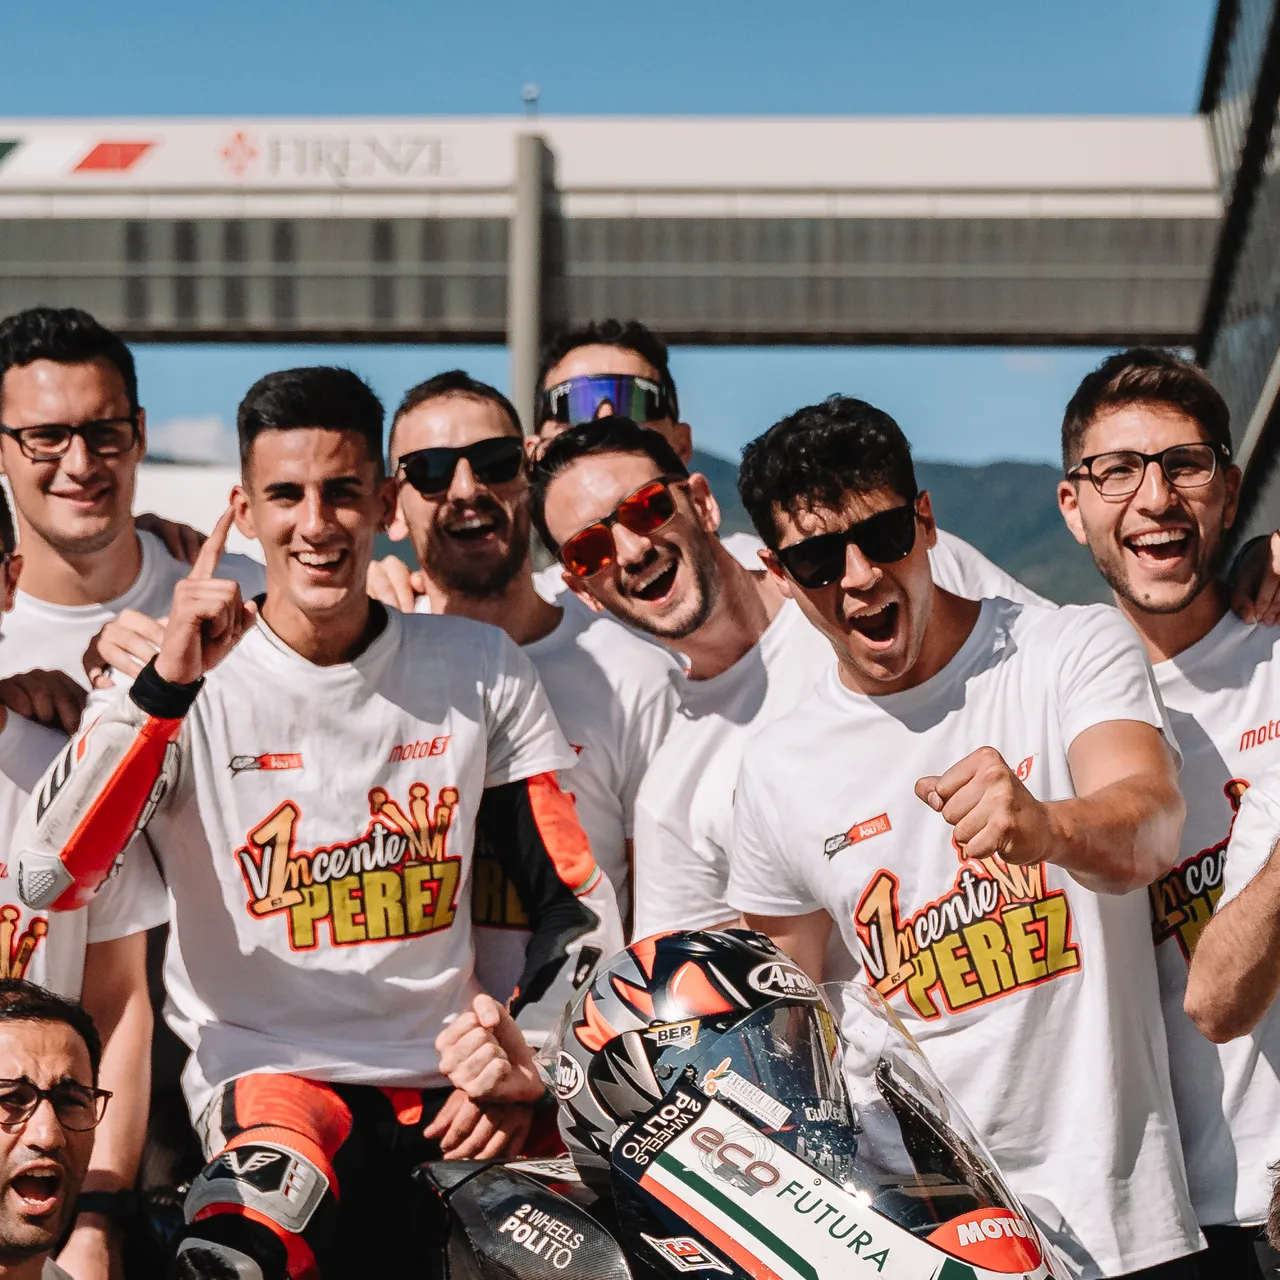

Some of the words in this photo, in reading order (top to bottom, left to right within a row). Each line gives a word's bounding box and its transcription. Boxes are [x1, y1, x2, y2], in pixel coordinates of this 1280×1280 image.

[266, 132, 458, 184] FIRENZE
[388, 735, 450, 764] moto3
[291, 860, 461, 948] PEREZ
[910, 897, 1078, 1017] PEREZ
[622, 1090, 690, 1159] POLITO
[686, 1100, 702, 1113] 2
[635, 1113, 694, 1166] WHEELS
[498, 1216, 573, 1269] POLITO
[515, 1203, 532, 1218] 2
[528, 1208, 585, 1250] WHEELS
[776, 1180, 894, 1274] FUTURA
